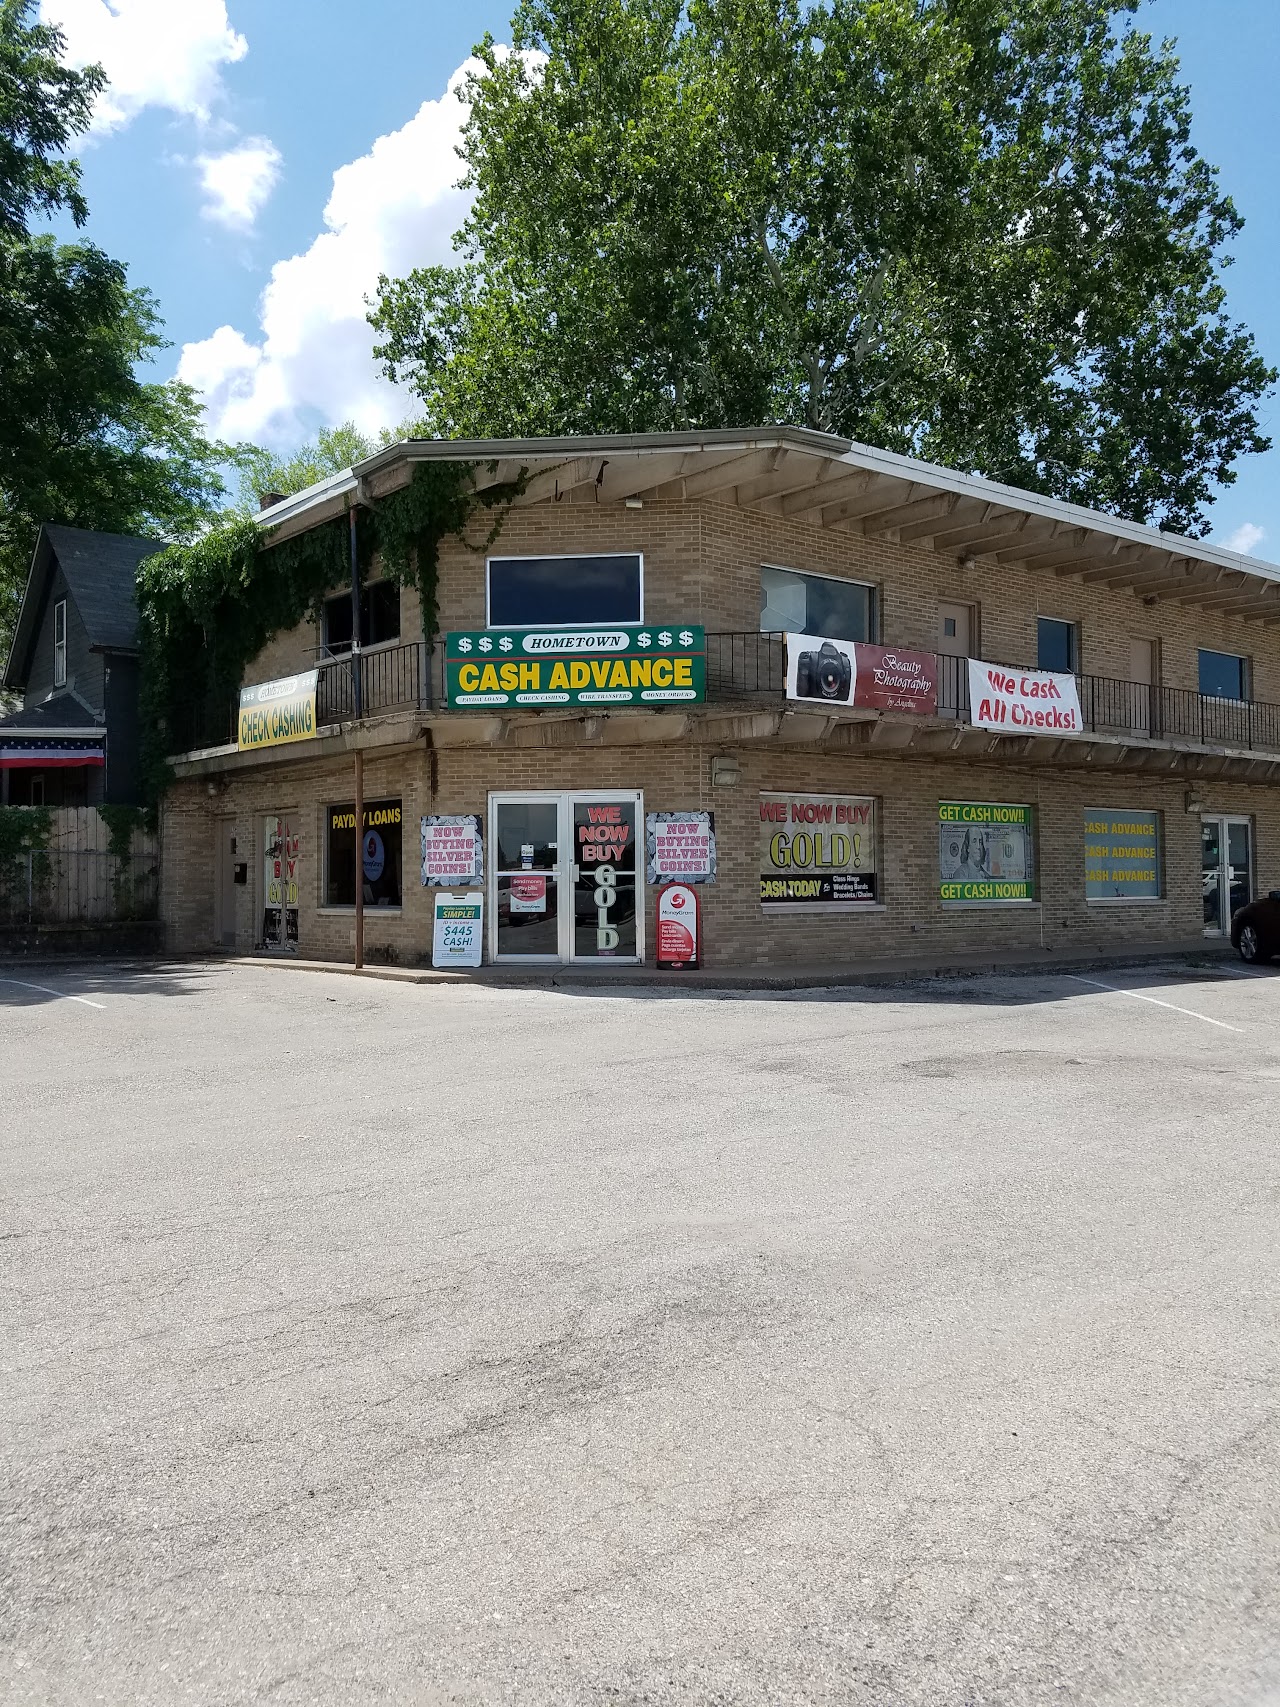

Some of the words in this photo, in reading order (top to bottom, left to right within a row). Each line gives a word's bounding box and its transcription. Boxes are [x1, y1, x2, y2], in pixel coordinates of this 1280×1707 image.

[530, 636, 621, 649] HOMETOWN
[881, 653, 922, 677] Beauty
[458, 662, 540, 692] CASH
[548, 658, 693, 689] ADVANCE
[873, 667, 932, 694] Photography
[987, 670, 1016, 693] We
[1019, 676, 1062, 699] Cash
[241, 709, 270, 745] CHECK
[272, 699, 312, 738] CASHING
[978, 698, 1013, 723] All
[1011, 703, 1077, 730] Checks!
[368, 807, 402, 826] LOANS
[587, 807, 621, 824] WE
[760, 802, 787, 822] WE
[791, 803, 832, 824] NOW
[835, 805, 870, 825] BUY
[939, 806, 960, 822] GET
[962, 807, 991, 822] CASH
[993, 808, 1025, 823] NOW!!
[432, 827, 464, 838] NOW
[579, 825, 629, 843] NOW
[666, 823, 699, 834] NOW
[1111, 823, 1155, 836] ADVANCE
[426, 838, 474, 850] BUYING
[656, 836, 709, 847] BUYING
[427, 850, 474, 863] SILVER
[582, 844, 625, 862] BUY
[657, 848, 708, 859] SILVER
[769, 832, 862, 869] GOLD!
[1112, 847, 1155, 858] ADVANCE
[427, 862, 472, 875] COINS!
[659, 860, 707, 872] COINS!
[1112, 870, 1156, 882] ADVANCE
[760, 880, 787, 898] CASH
[788, 880, 822, 897] TODAY
[833, 883, 853, 892] Wedding
[854, 883, 868, 891] Bands
[940, 884, 963, 900] GET
[964, 884, 993, 899] CASH
[995, 883, 1027, 898] NOW!!
[442, 911, 475, 919] SIMPLE!
[594, 864, 620, 951] GOLD
[444, 925, 473, 937] $445
